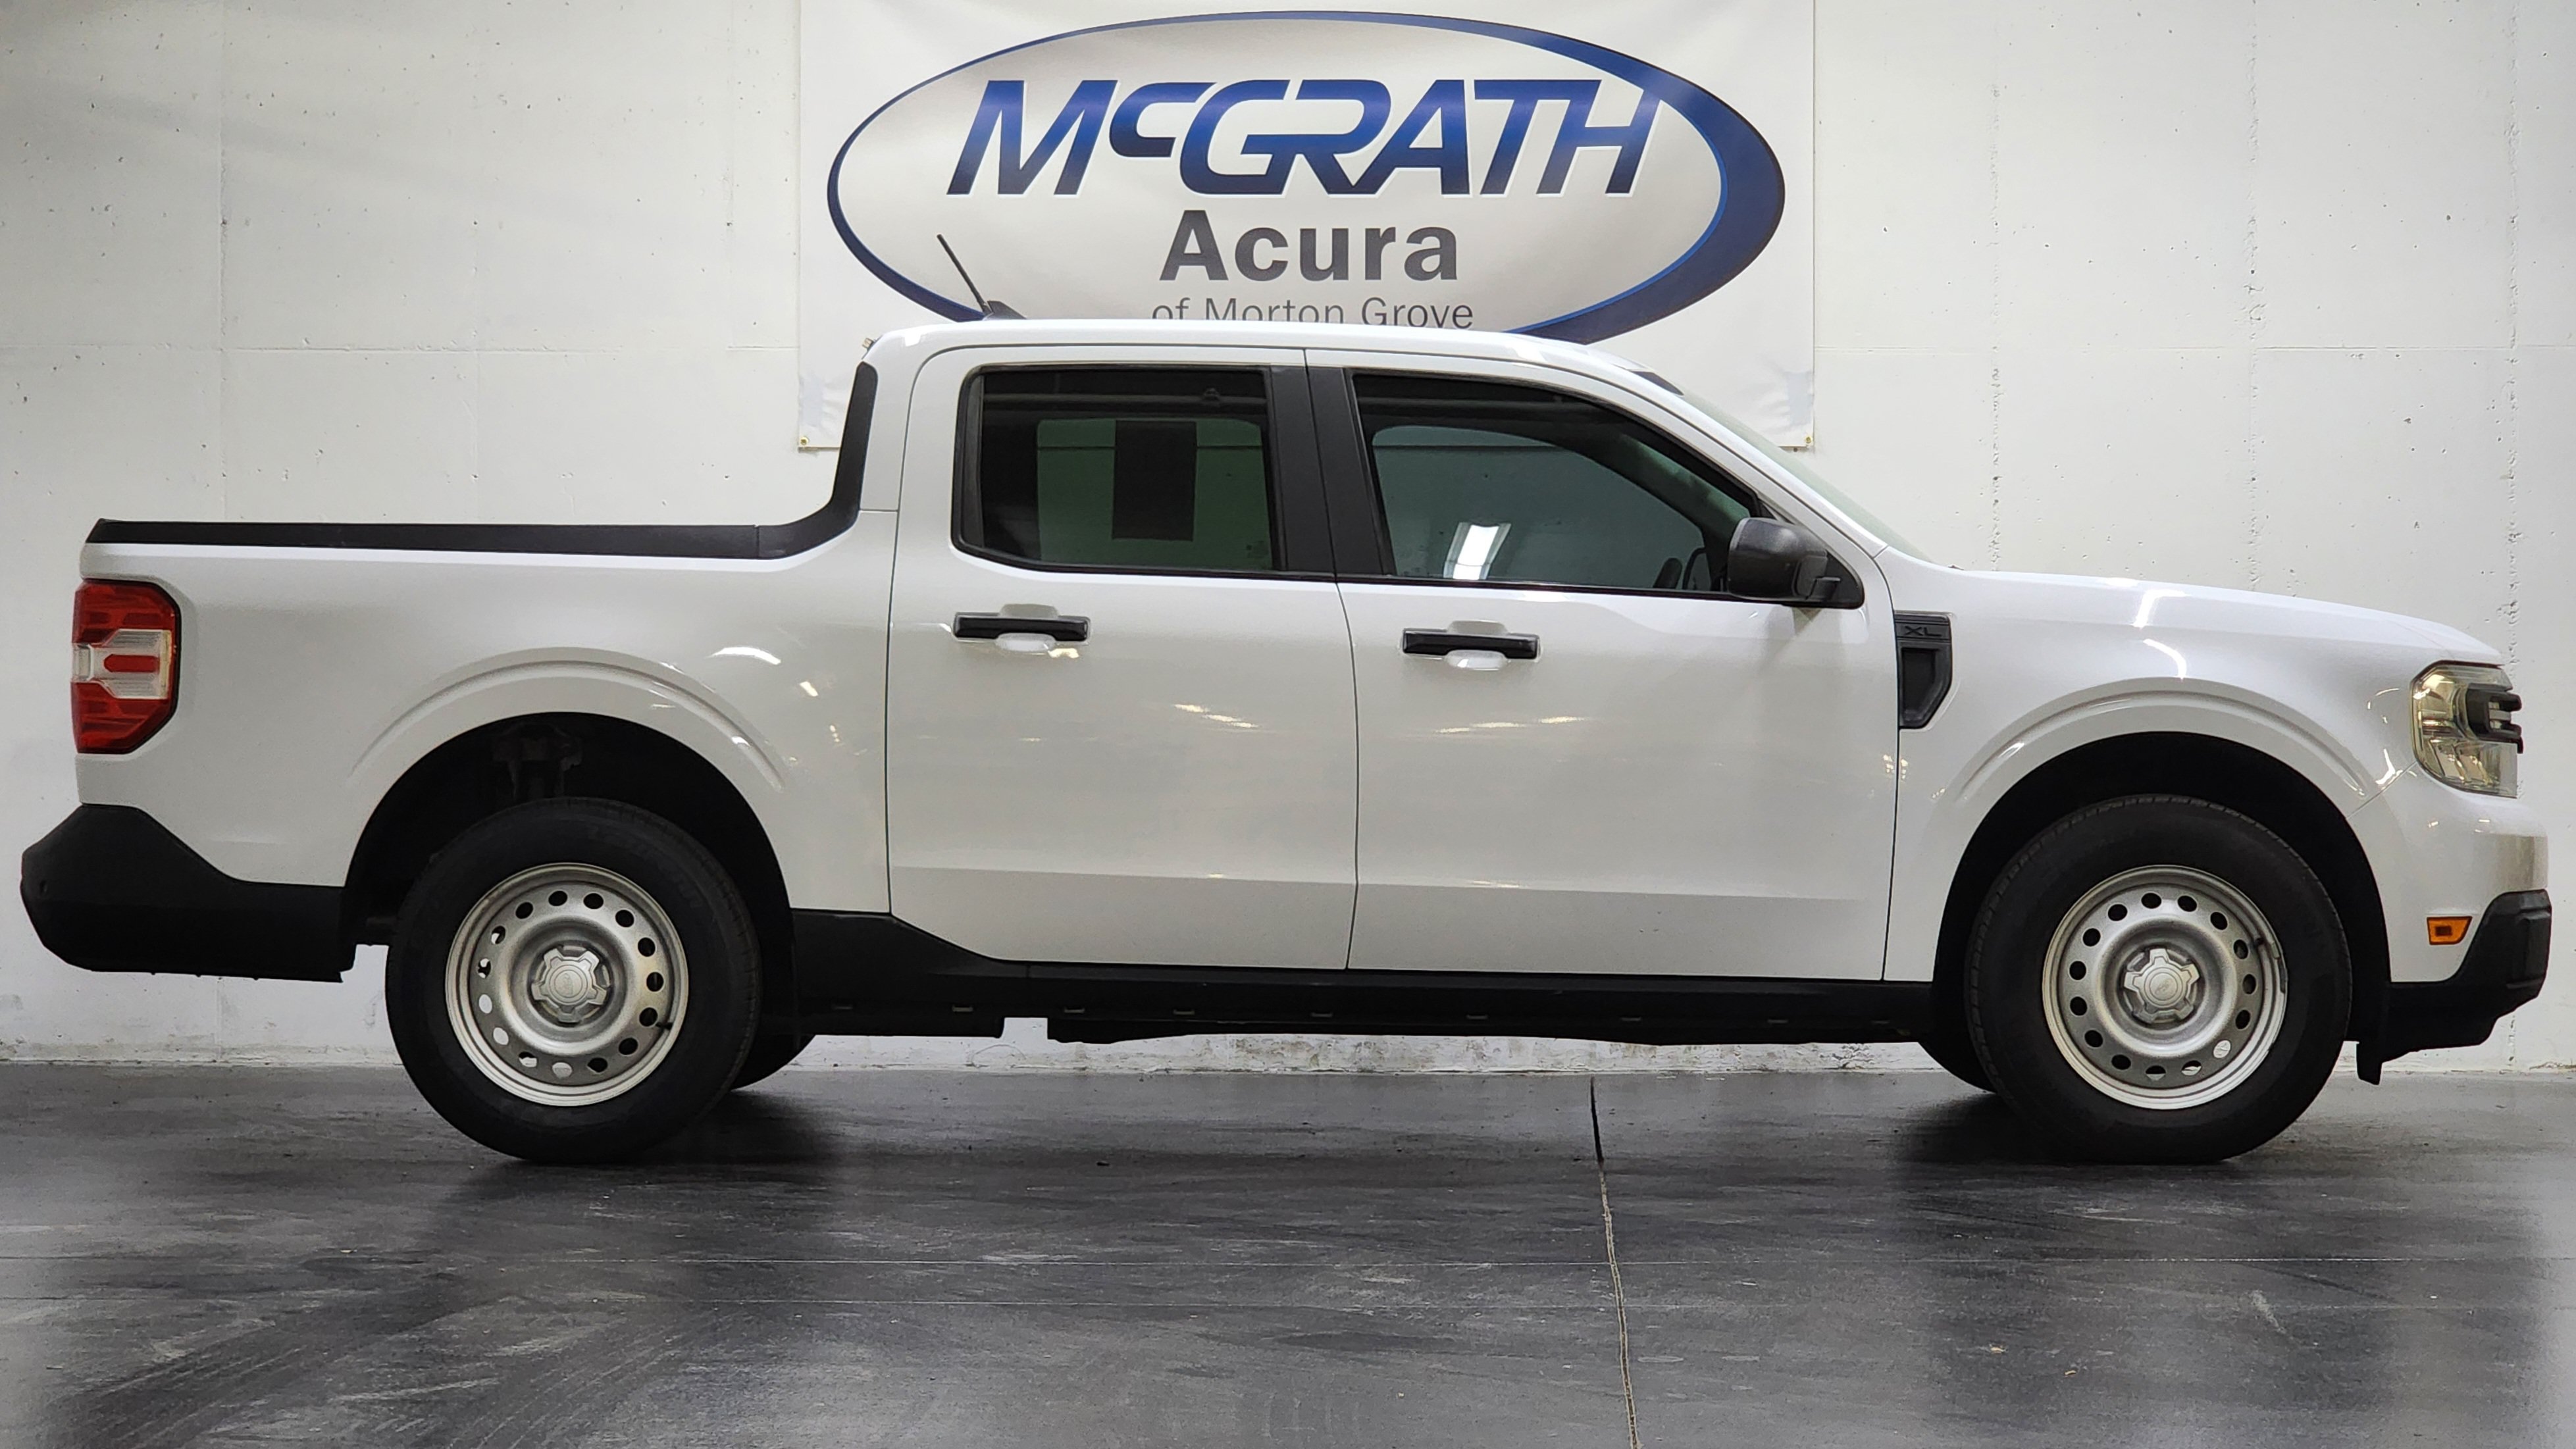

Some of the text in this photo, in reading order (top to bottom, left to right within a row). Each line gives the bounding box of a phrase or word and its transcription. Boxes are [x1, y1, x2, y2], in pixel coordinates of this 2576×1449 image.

[1159, 209, 1458, 282] Acura
[1152, 297, 1473, 329] of Morton Grove
[1905, 626, 1942, 636] XL
